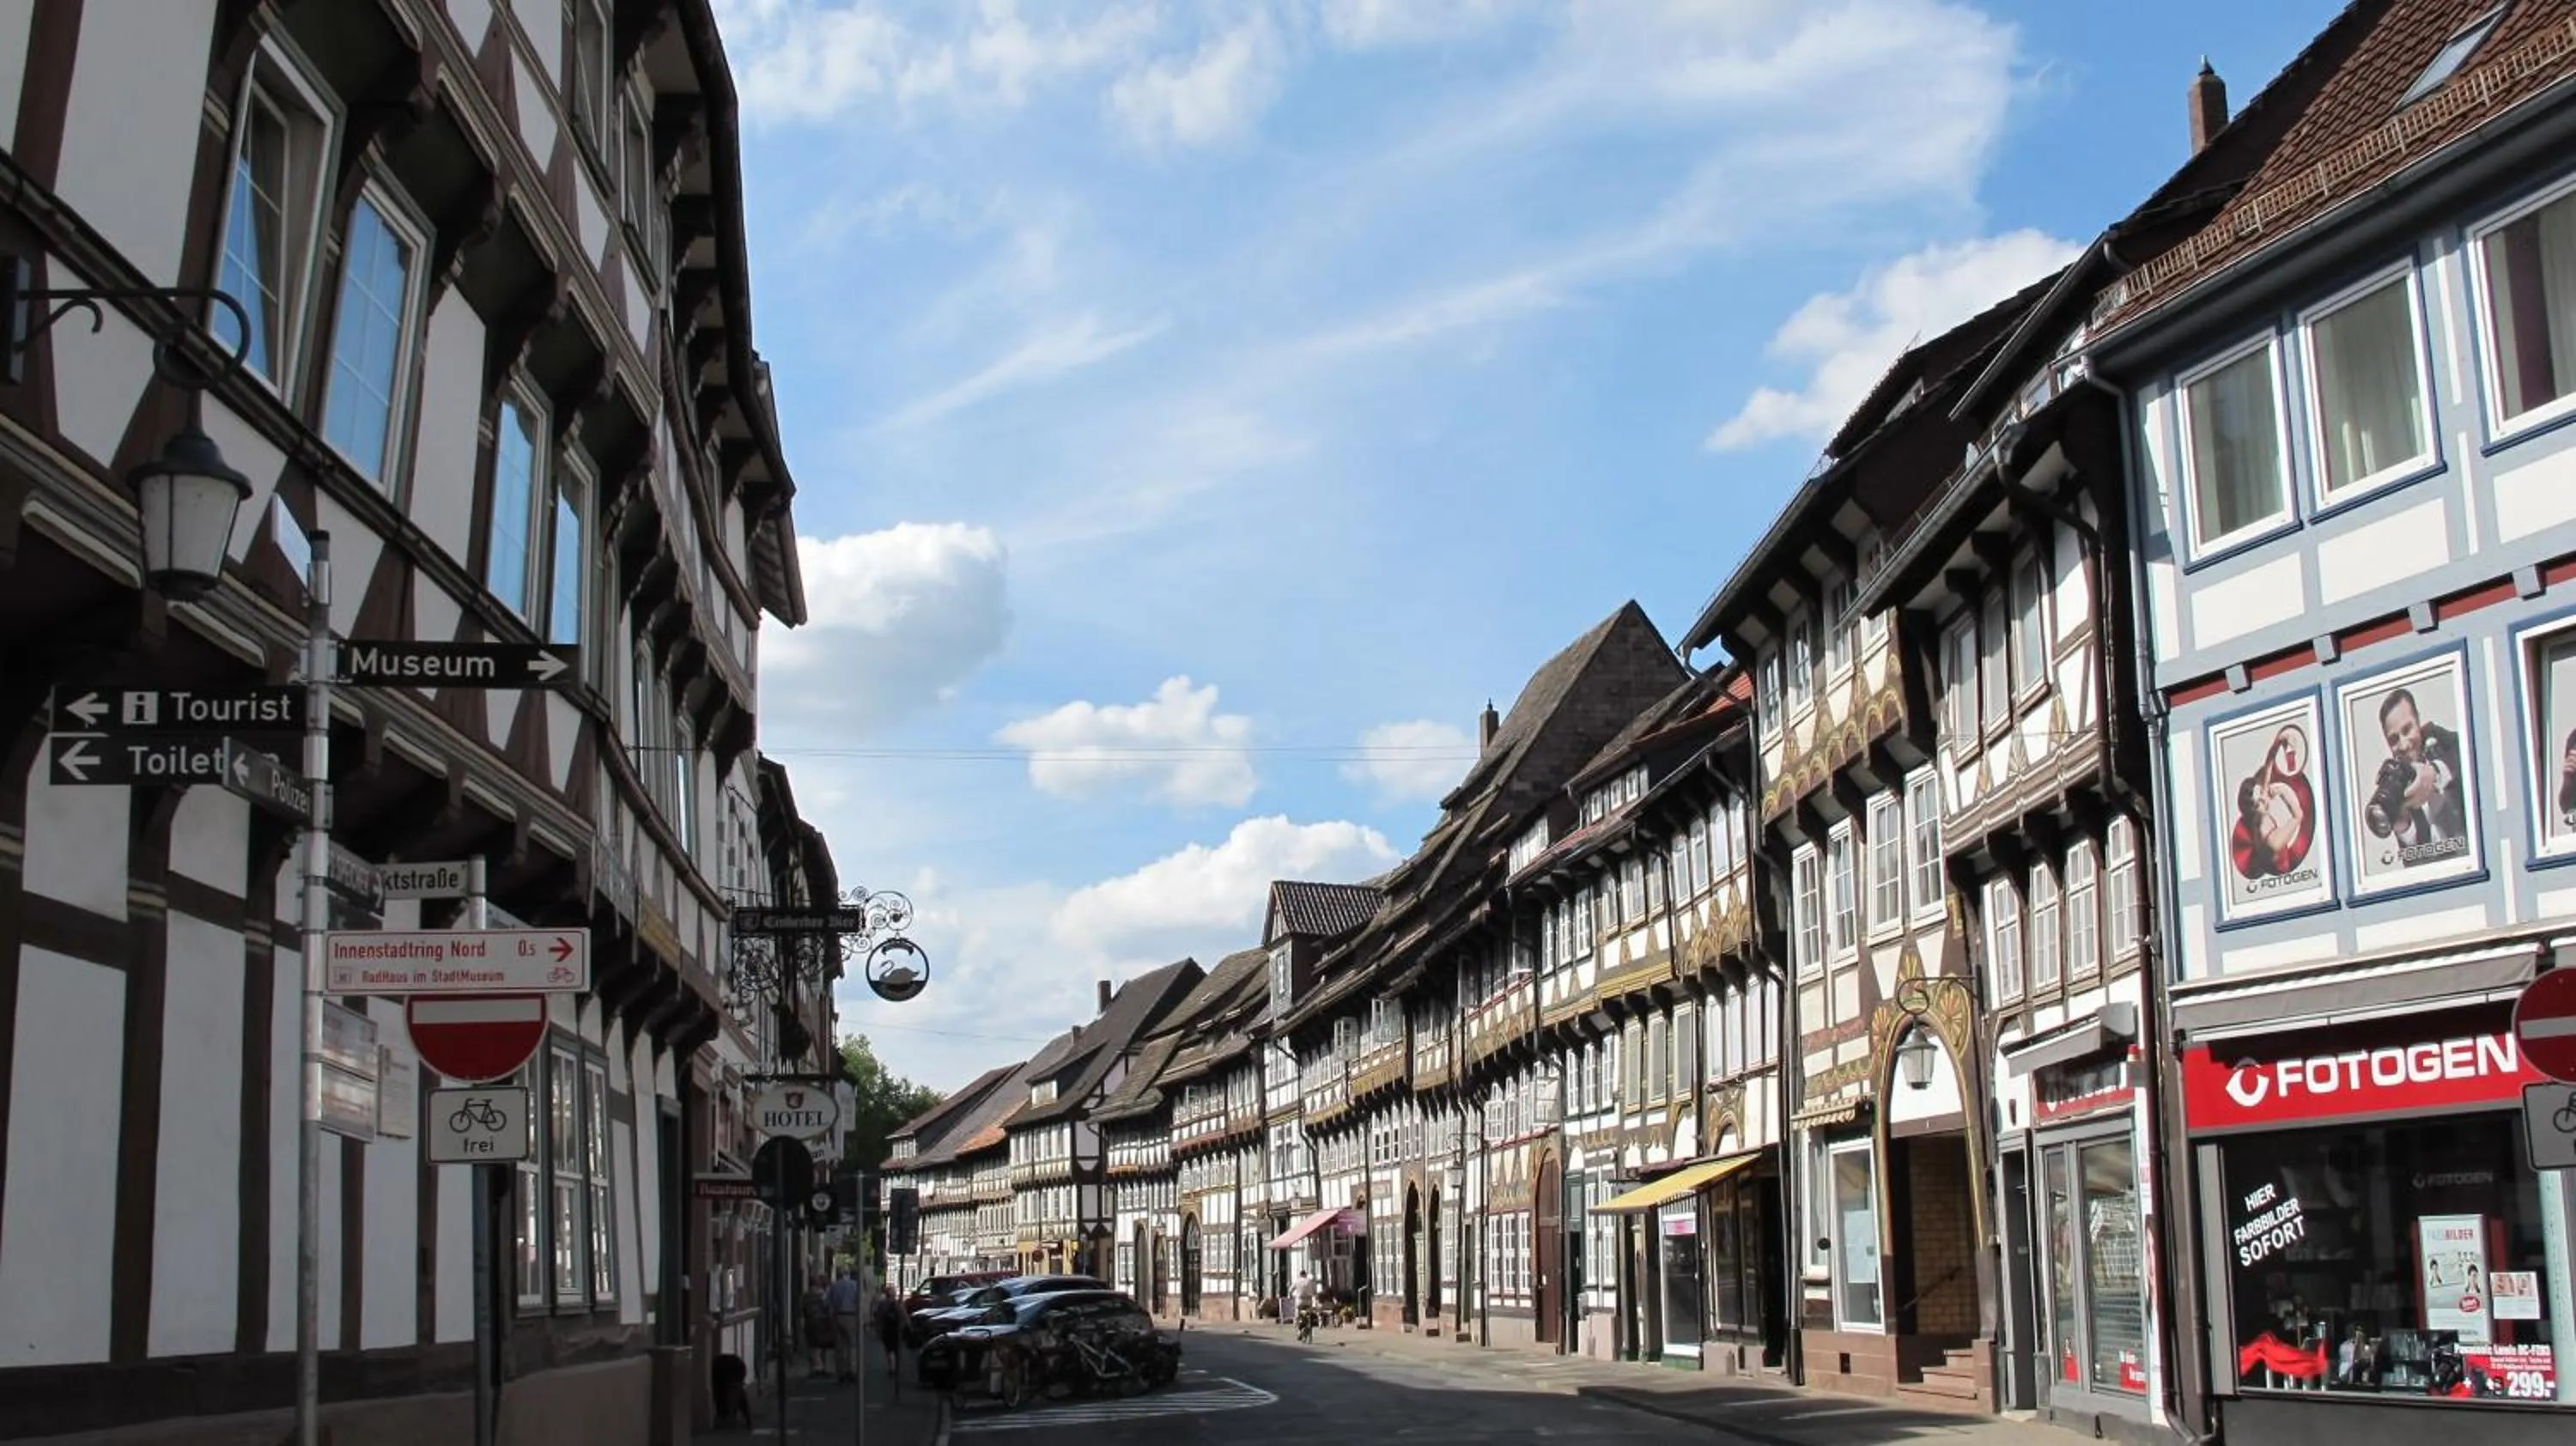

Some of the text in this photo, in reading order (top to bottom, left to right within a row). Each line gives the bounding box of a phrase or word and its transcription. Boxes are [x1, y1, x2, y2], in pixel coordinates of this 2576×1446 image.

[350, 643, 496, 677] Museum
[170, 692, 292, 722] Tourist
[128, 745, 280, 775] Toilet
[2397, 837, 2465, 863] FOTOGEN
[385, 867, 459, 890] ktstraße
[2260, 869, 2319, 893] FOTOGEN
[334, 942, 443, 961] Innenstadtring
[451, 940, 486, 957] Nord
[413, 969, 427, 983] im
[432, 969, 504, 982] StadtMuseum
[2276, 1031, 2518, 1098] FOTOGEN
[764, 1111, 824, 1128] HOTEL
[463, 1135, 495, 1153] frei
[2244, 1183, 2276, 1212] HIER
[2233, 1197, 2300, 1246] FARBBILDER
[2239, 1215, 2305, 1267] SOFORT
